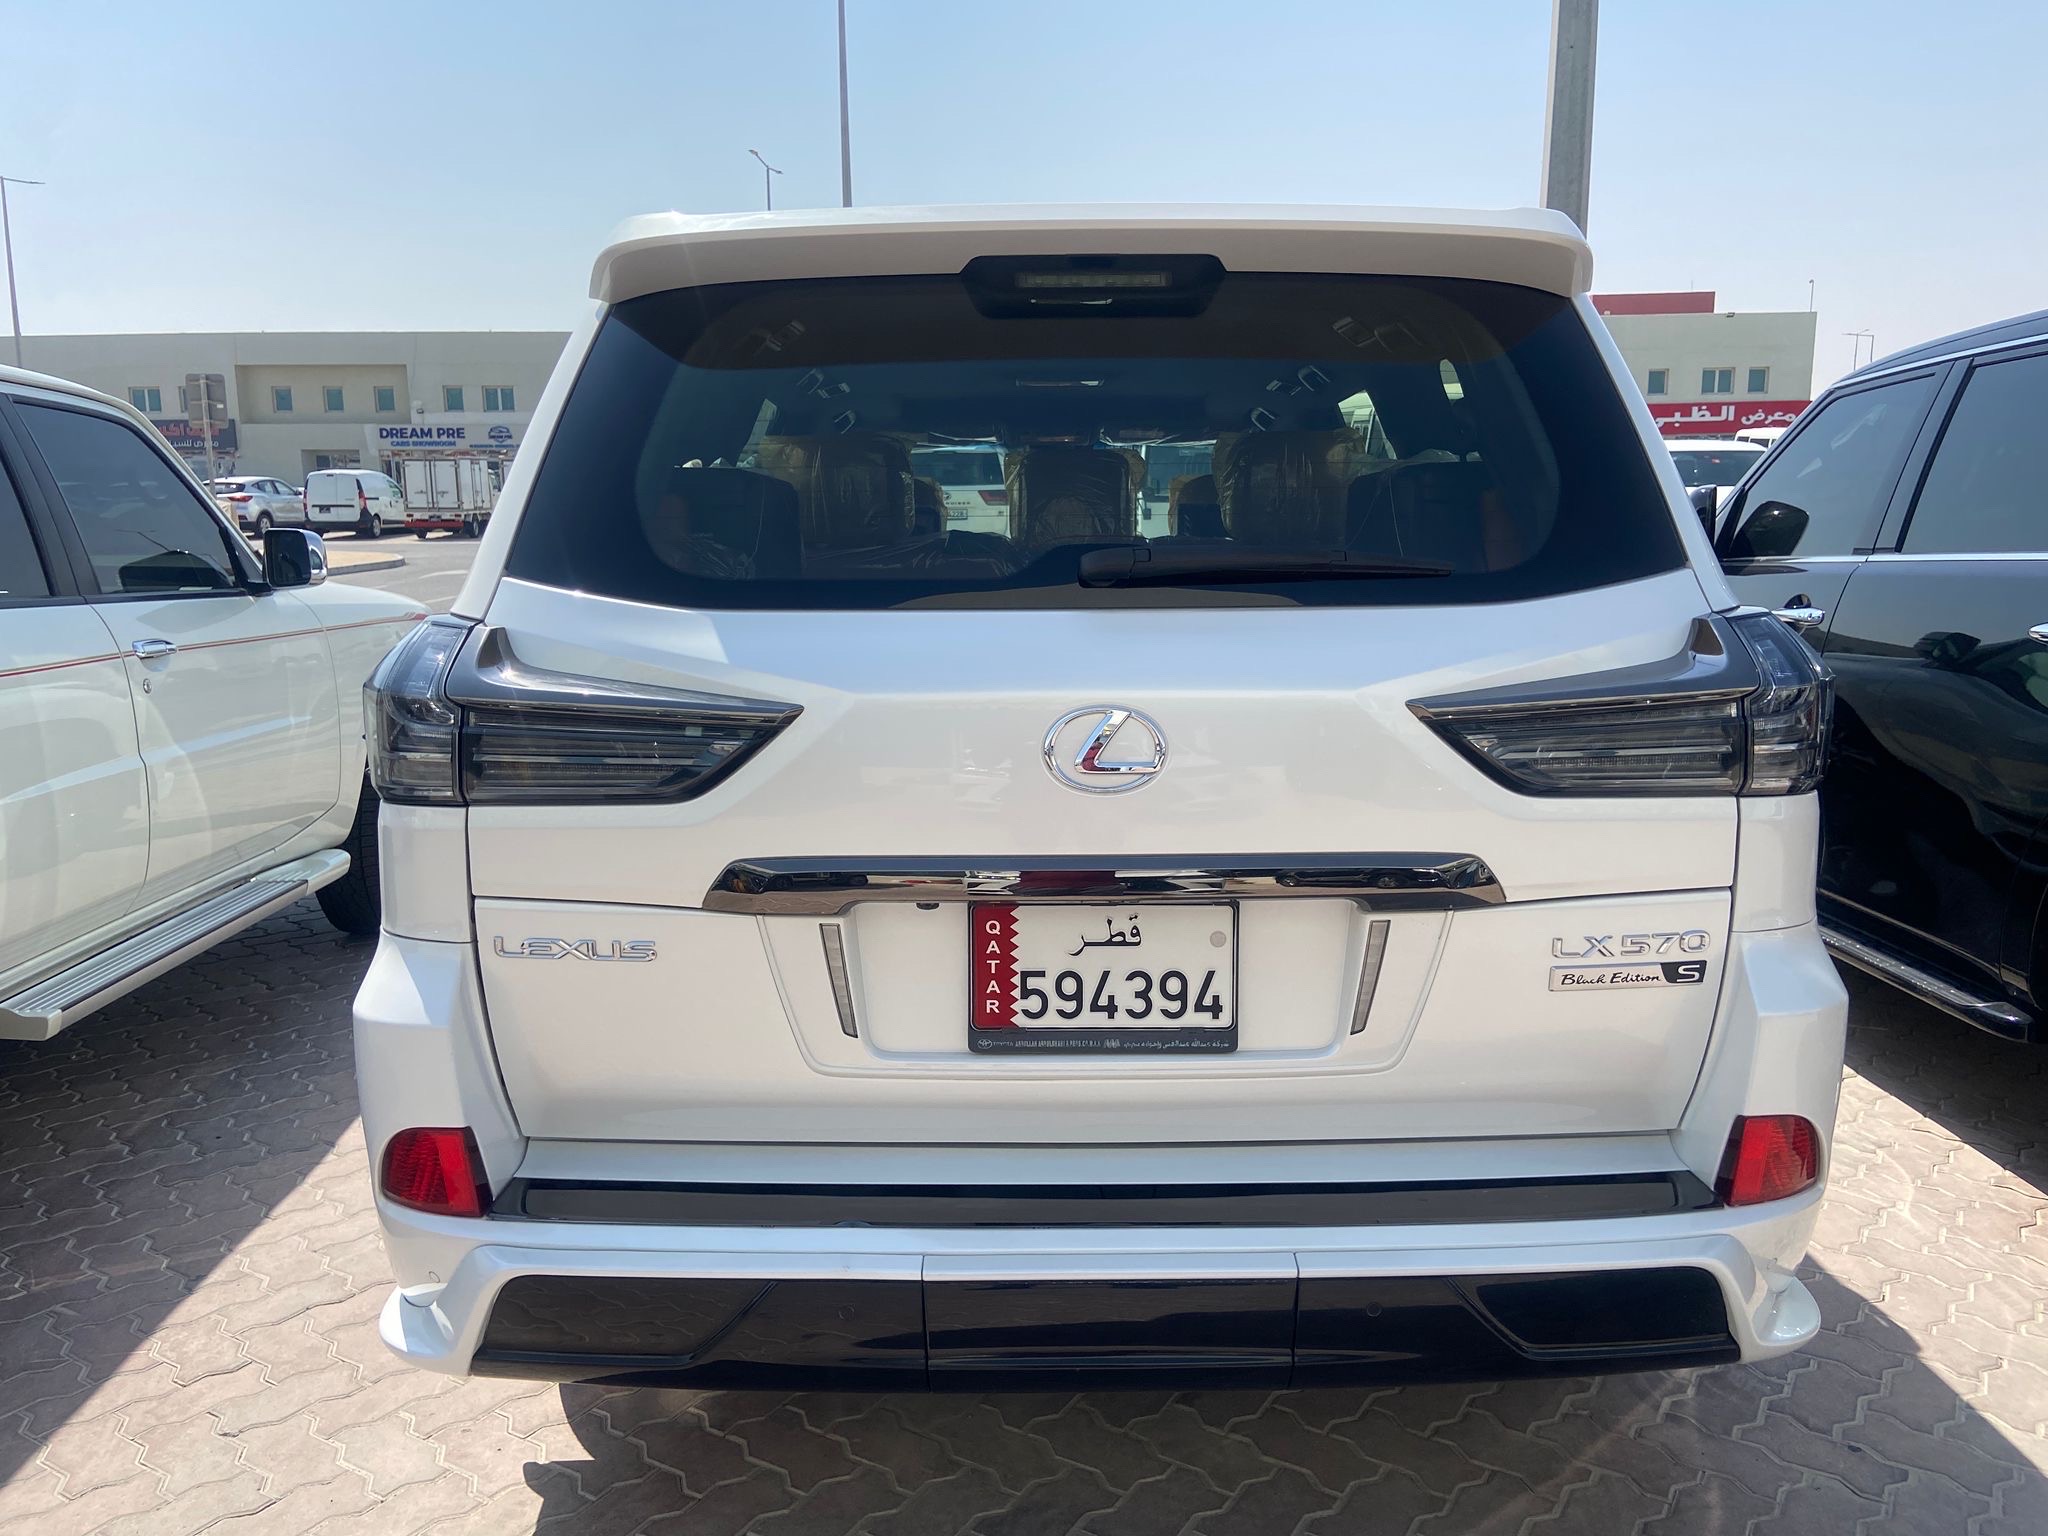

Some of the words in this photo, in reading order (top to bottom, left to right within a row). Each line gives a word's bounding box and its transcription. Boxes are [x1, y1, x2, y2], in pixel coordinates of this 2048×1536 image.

[1741, 408, 1797, 425] معرض
[379, 427, 433, 439] DREAM
[436, 427, 466, 439] PRE
[390, 440, 411, 448] CARS
[411, 440, 457, 448] SHOWROOM
[1067, 912, 1142, 957] قطر
[1620, 928, 1711, 957] 570
[493, 935, 658, 963] LEXUS
[985, 920, 1001, 1014] QATAR
[1560, 973, 1606, 986] Black
[1609, 971, 1661, 985] Edition
[1019, 970, 1223, 1020] 594394
